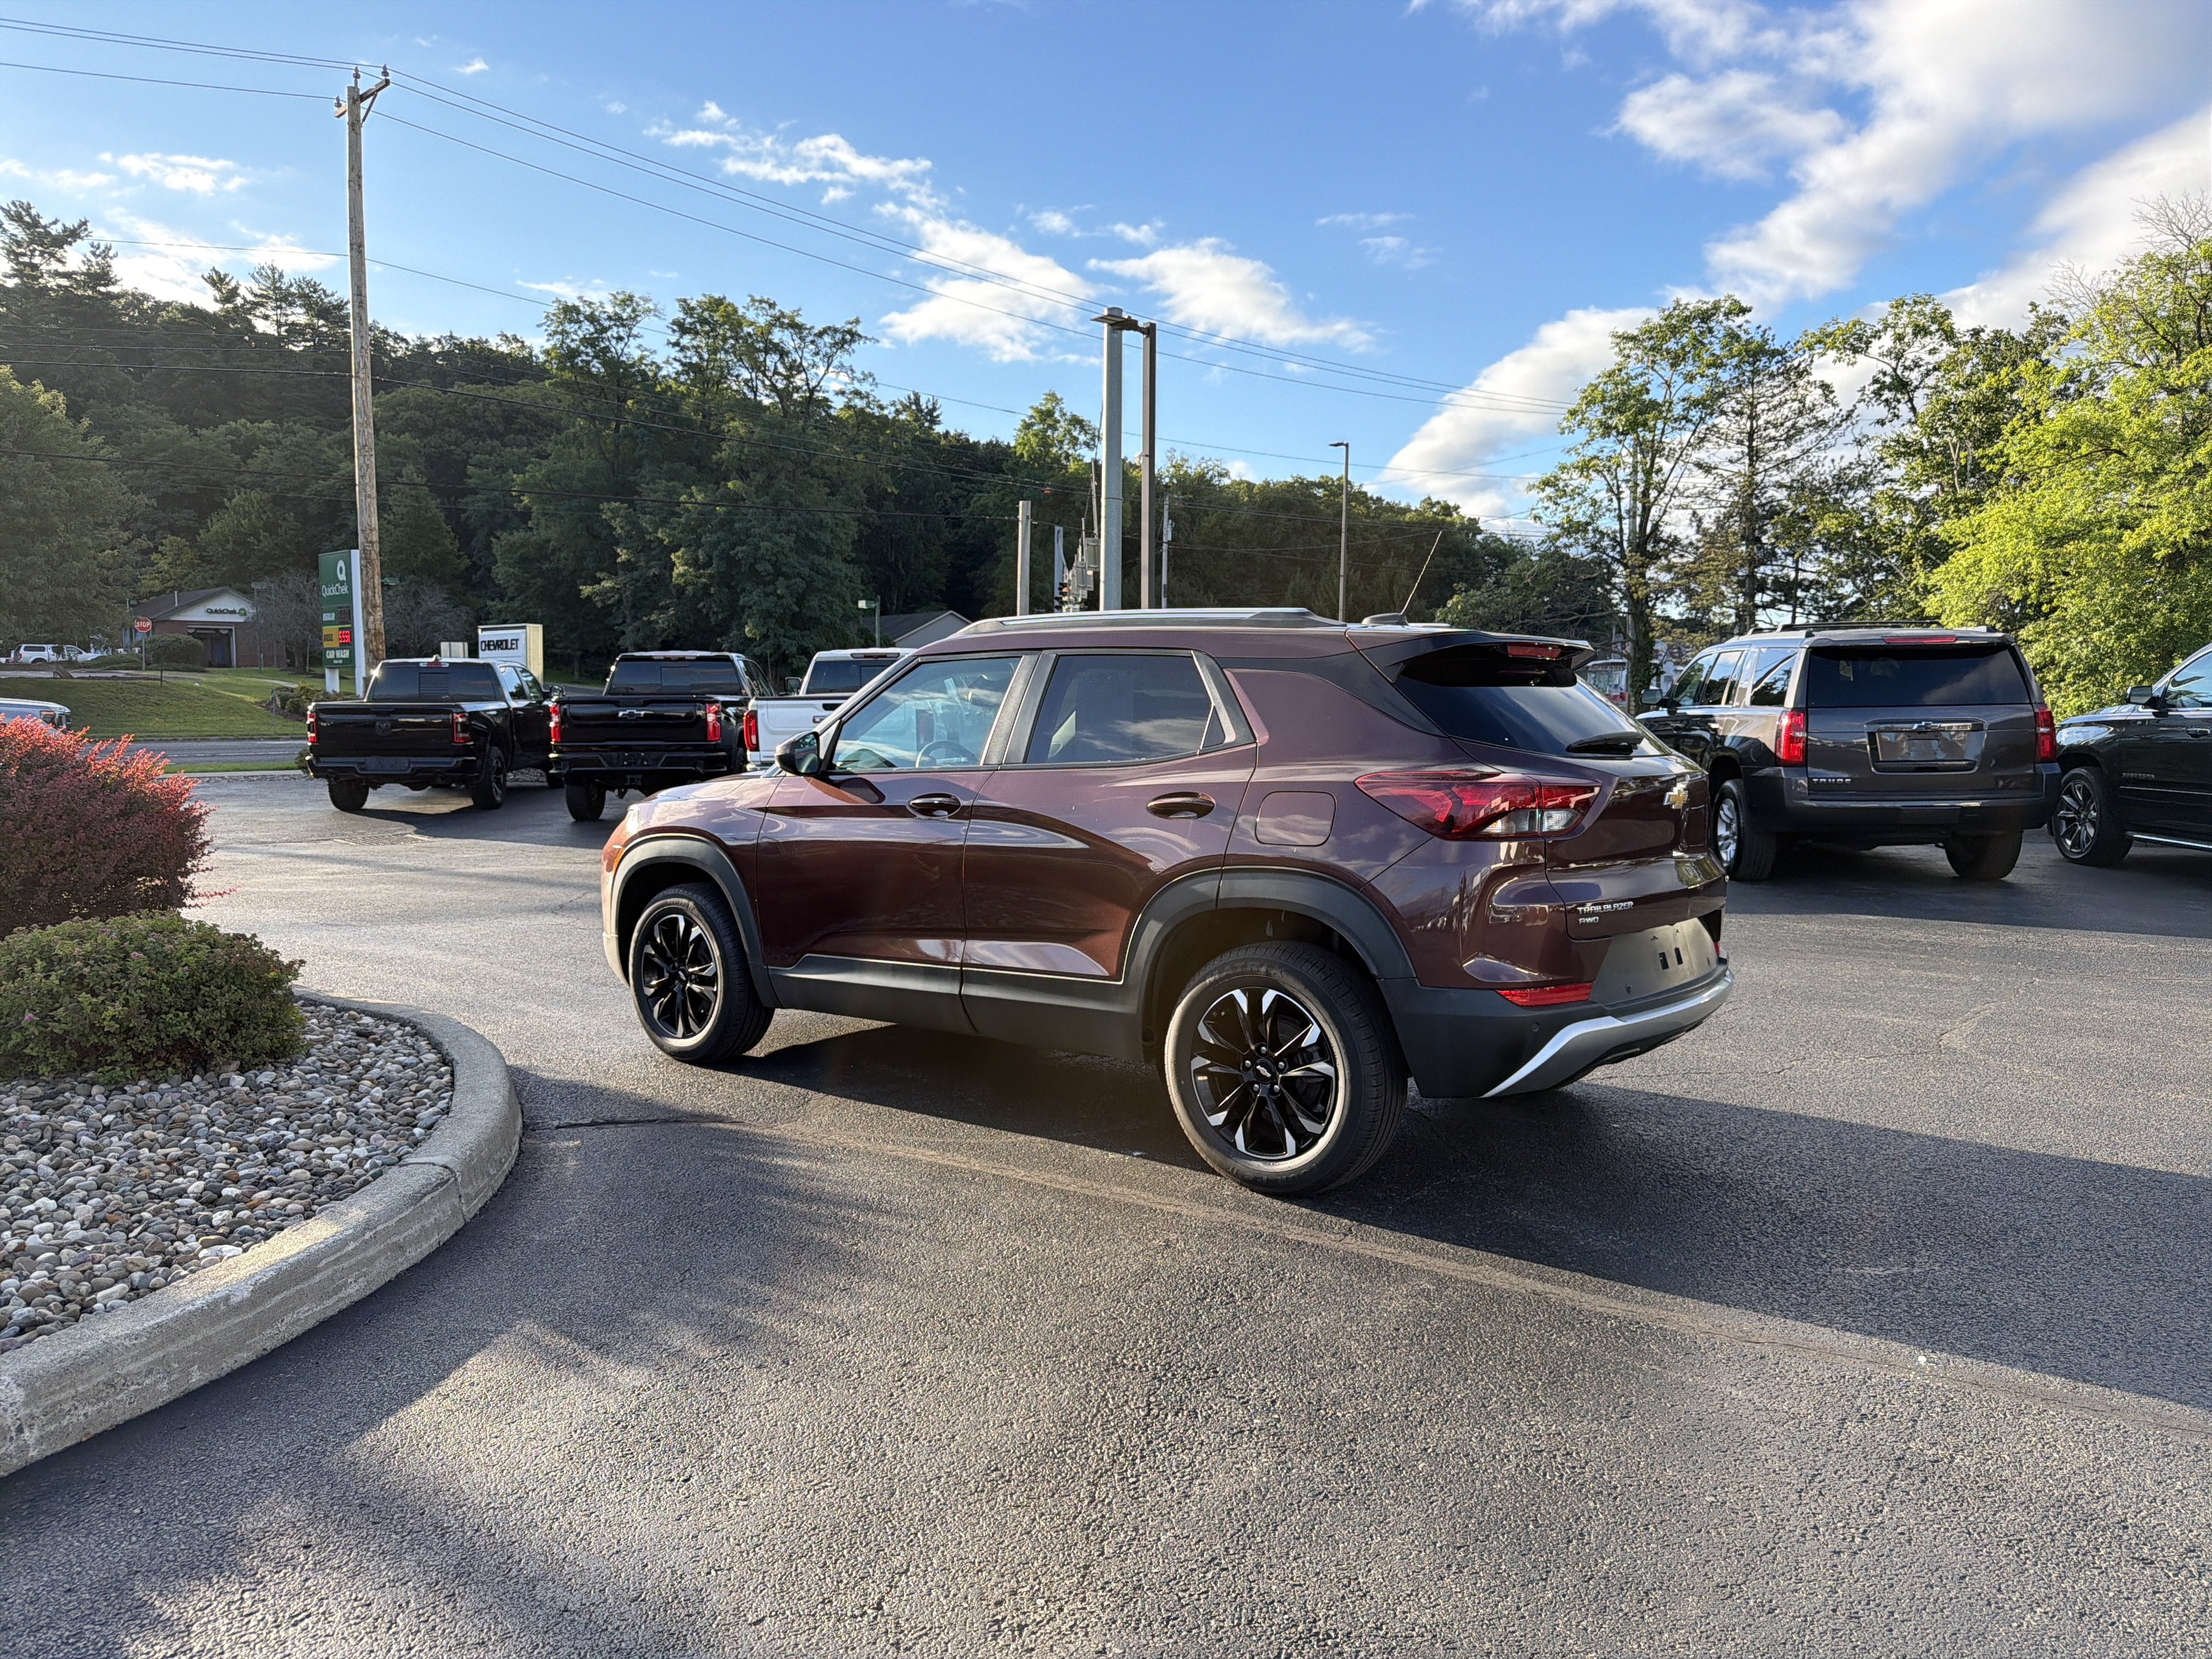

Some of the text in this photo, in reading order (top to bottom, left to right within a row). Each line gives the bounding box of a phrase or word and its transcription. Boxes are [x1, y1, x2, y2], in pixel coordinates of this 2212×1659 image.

[321, 582, 349, 598] QuickChek
[481, 638, 520, 652] CHEVROLET
[326, 650, 349, 659] CAR WASH
[1577, 901, 1634, 914] TRAILBLAZER
